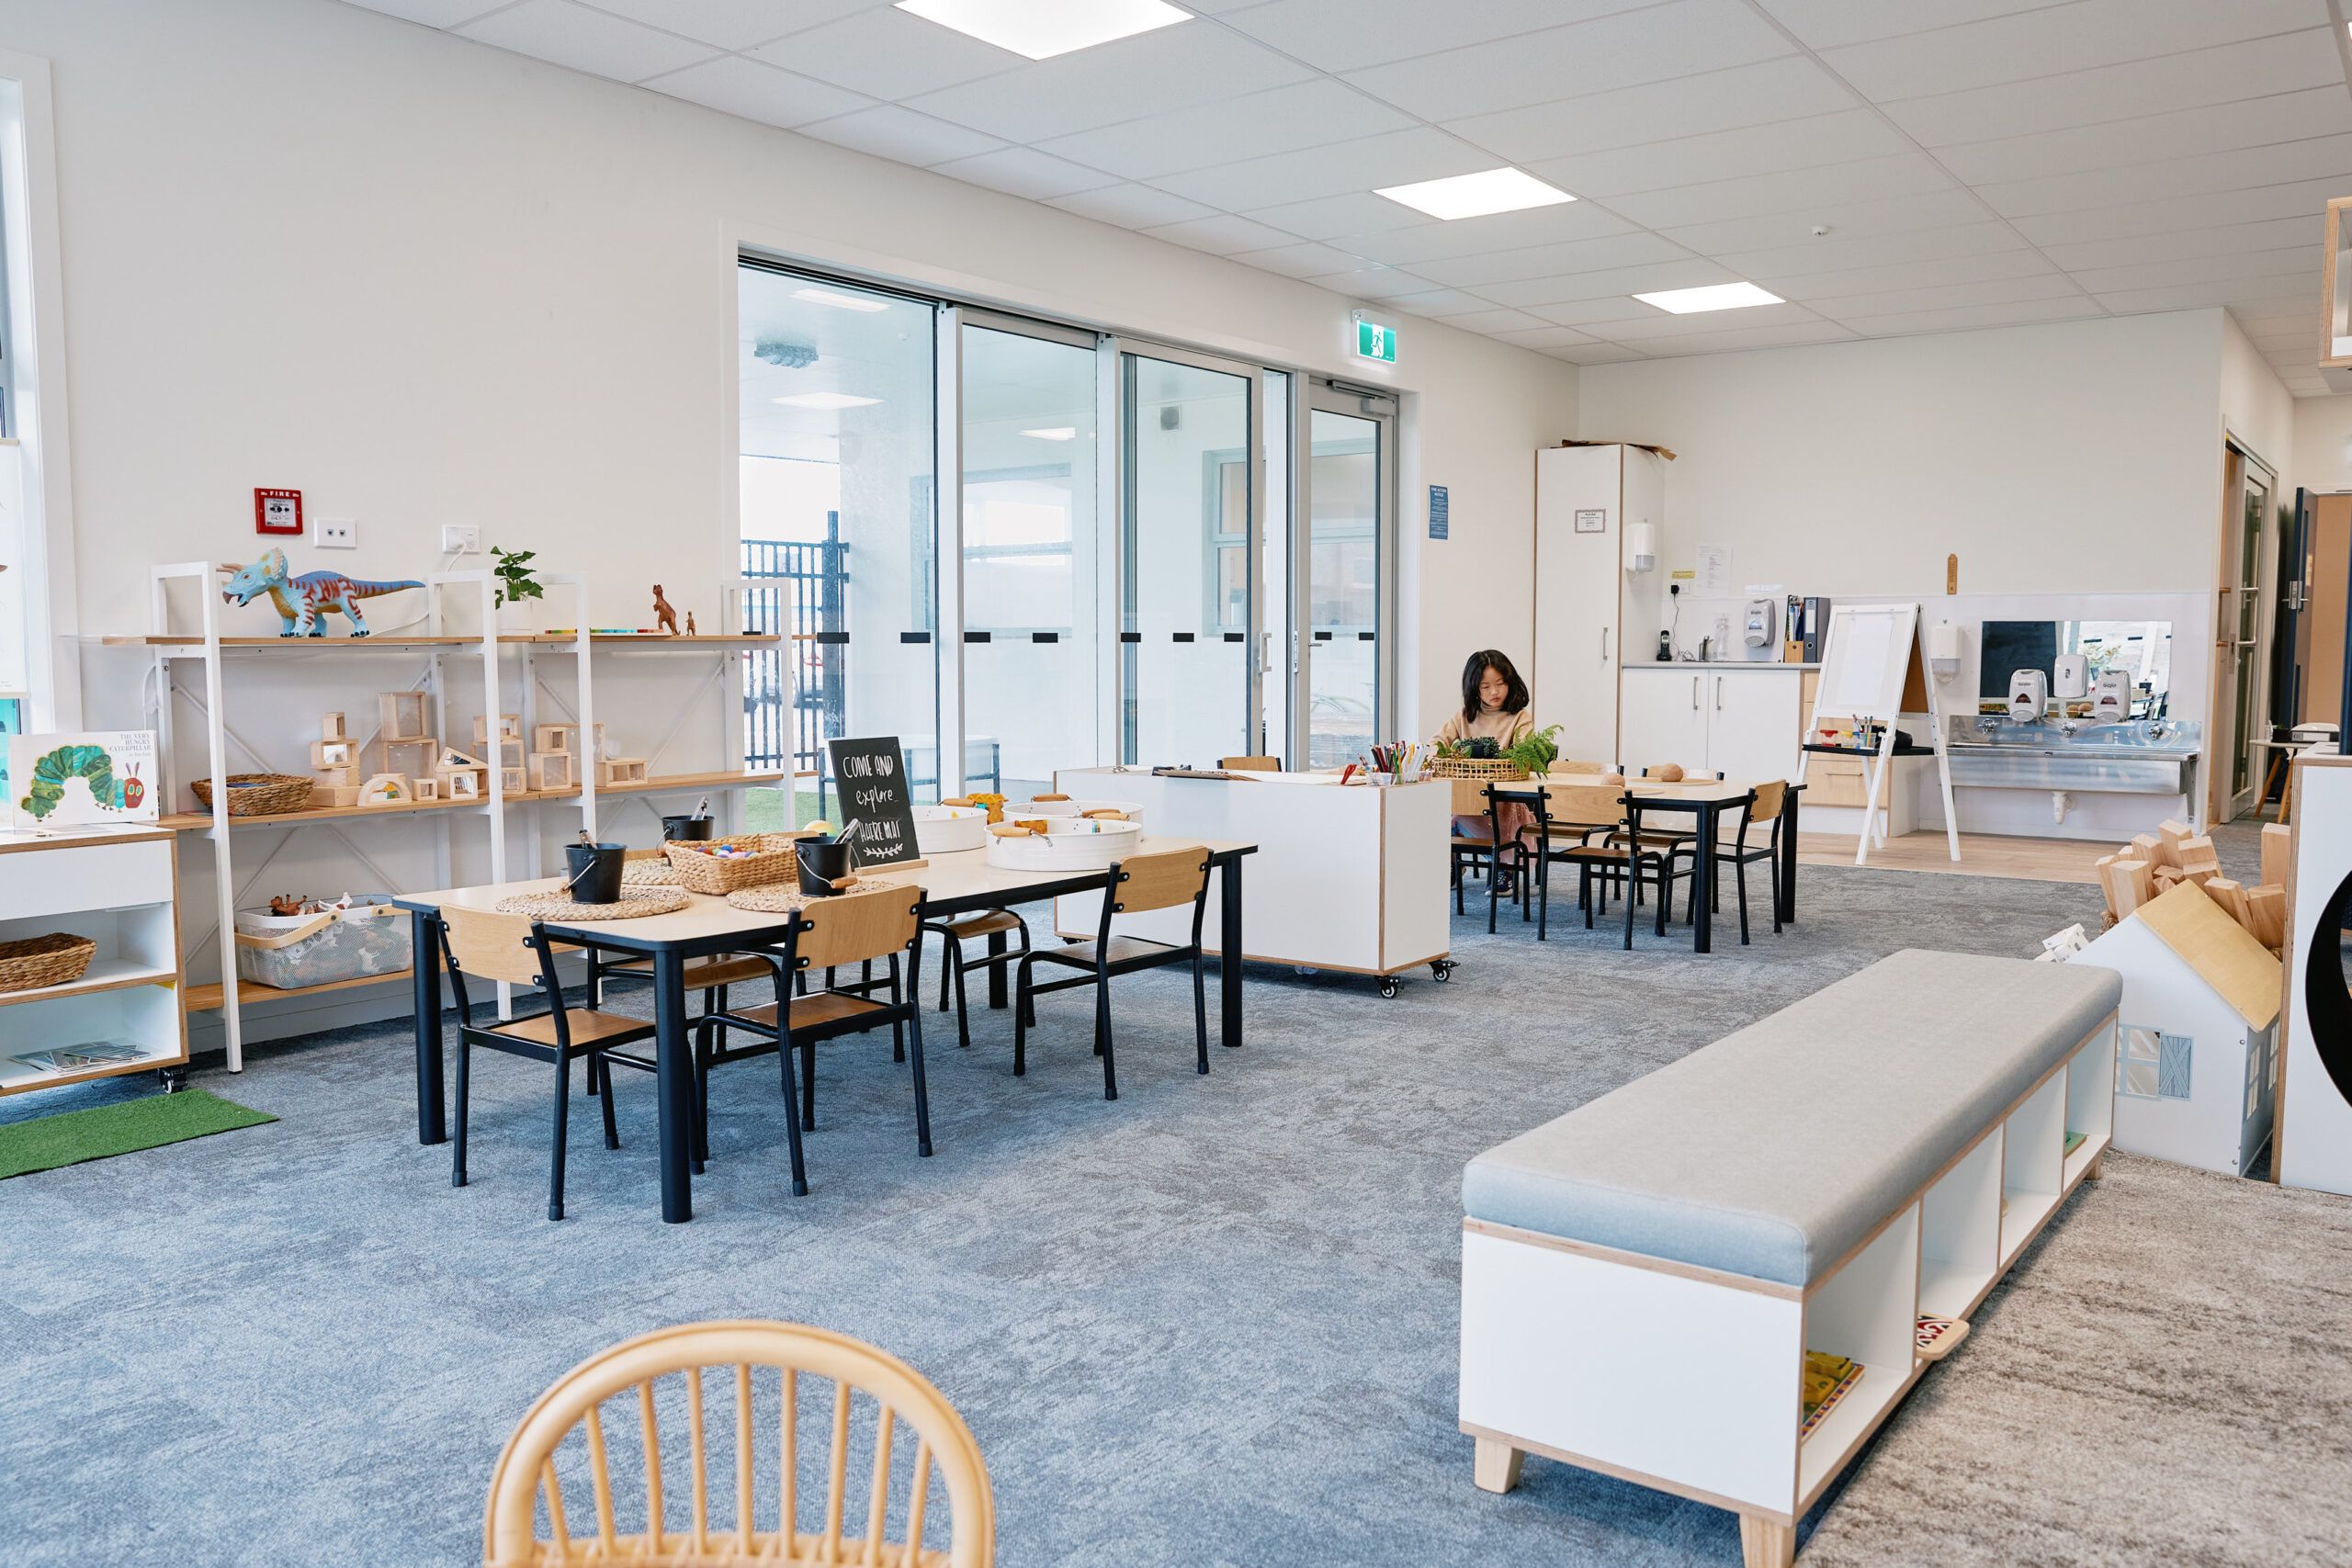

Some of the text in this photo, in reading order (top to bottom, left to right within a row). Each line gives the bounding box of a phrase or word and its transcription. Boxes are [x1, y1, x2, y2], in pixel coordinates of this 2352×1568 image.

[842, 754, 894, 778] COME AND
[858, 820, 885, 842] HAERE
